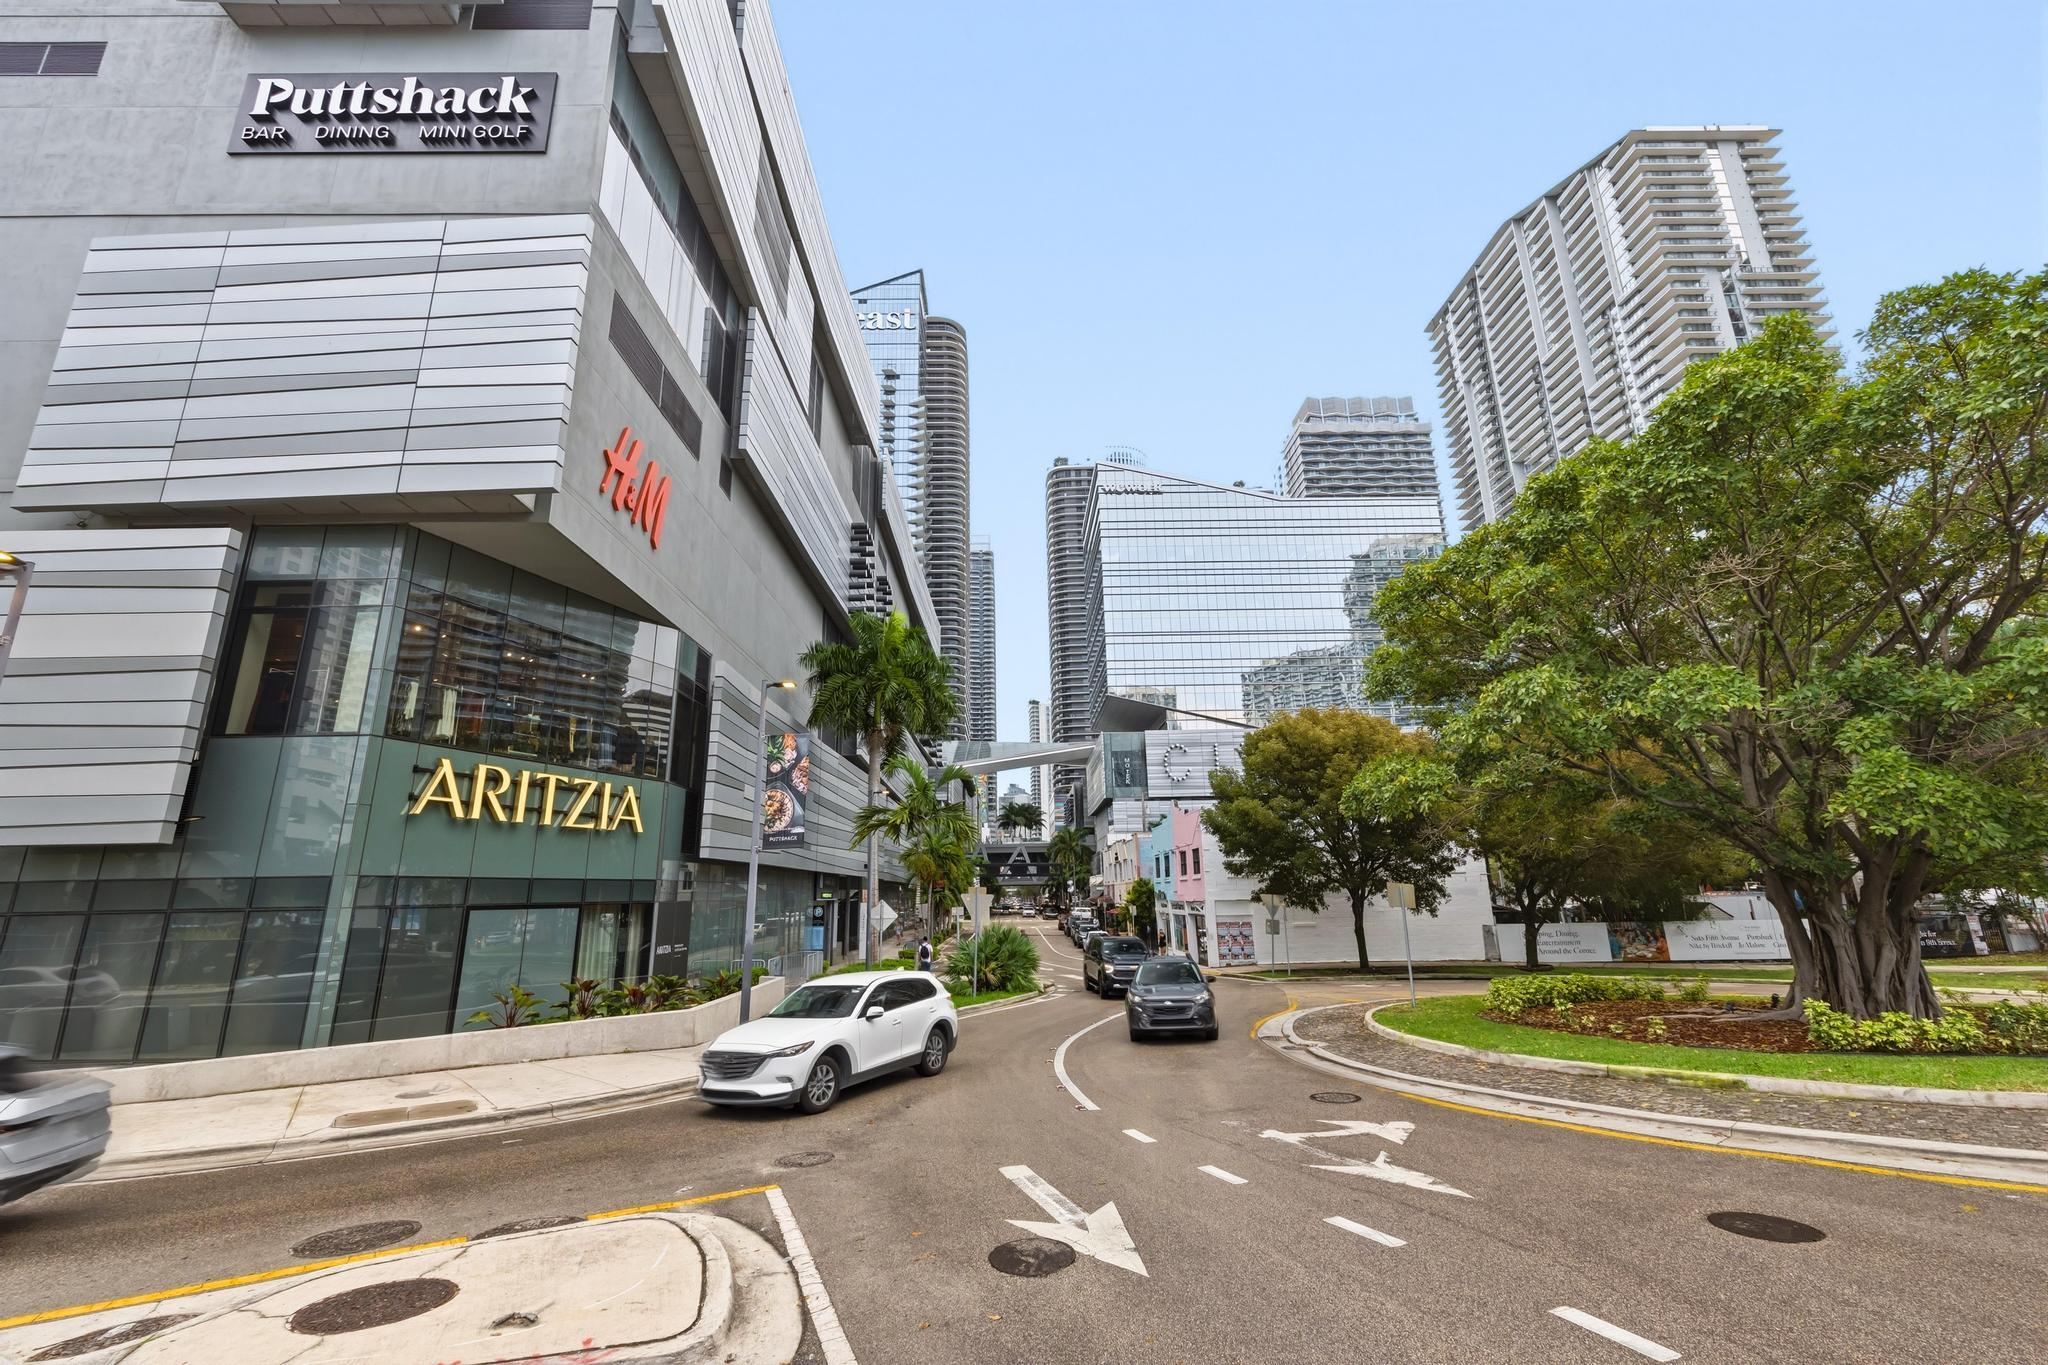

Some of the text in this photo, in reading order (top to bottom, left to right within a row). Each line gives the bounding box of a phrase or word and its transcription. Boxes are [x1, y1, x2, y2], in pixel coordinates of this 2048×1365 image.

[249, 75, 536, 117] Puttshack
[241, 125, 530, 140] BAR DINING MINI GOLF
[600, 426, 671, 551] H&M
[408, 757, 645, 834] ARITZIA
